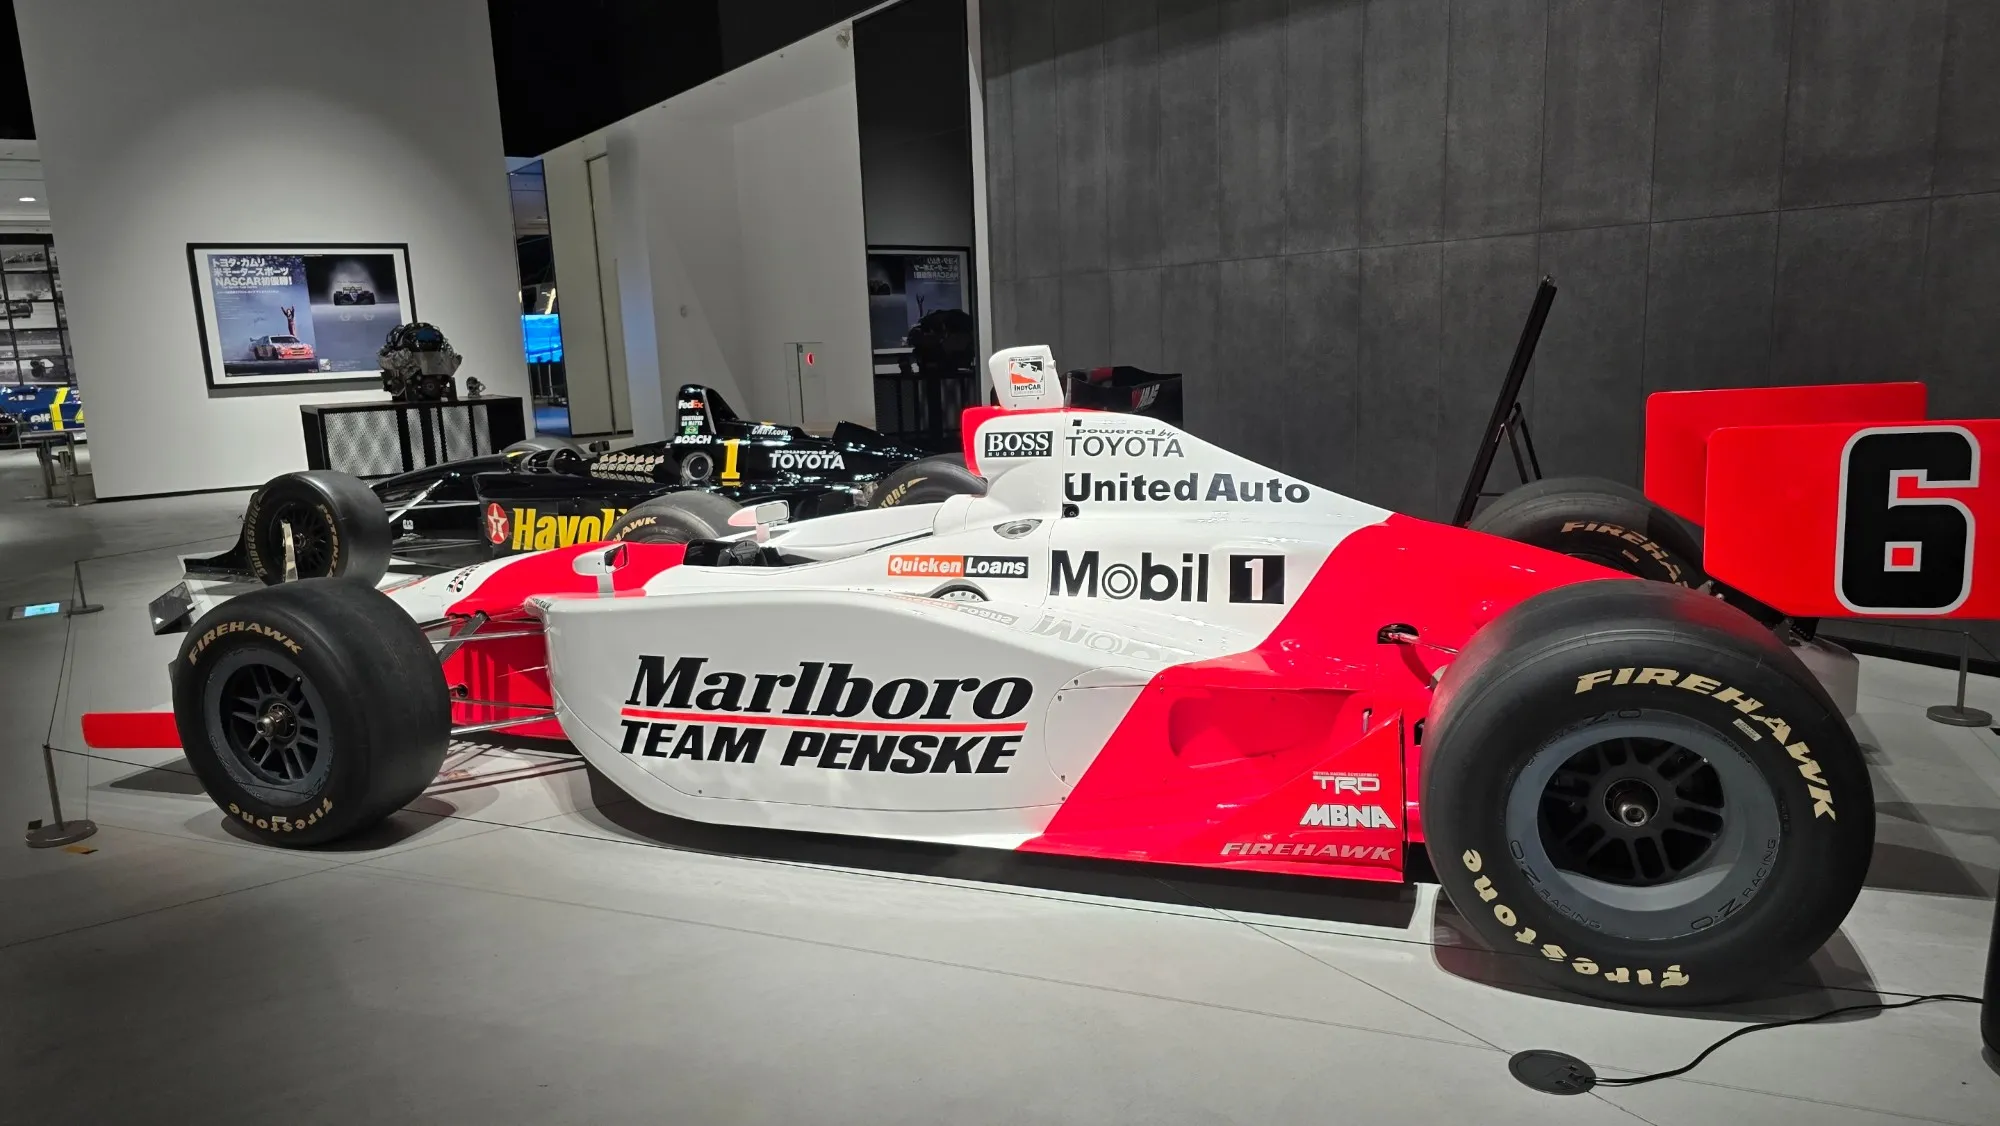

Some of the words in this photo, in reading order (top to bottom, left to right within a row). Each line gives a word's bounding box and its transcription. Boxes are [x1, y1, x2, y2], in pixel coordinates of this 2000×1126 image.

[678, 400, 704, 409] FedEx
[674, 434, 712, 444] BOSCH
[987, 432, 1050, 452] BOSS
[1065, 436, 1185, 458] TOYOTA
[1076, 428, 1156, 436] powered
[1157, 428, 1179, 439] by
[721, 438, 741, 480] 1
[768, 453, 845, 470] TOYOTA
[1064, 472, 1199, 503] United
[1204, 472, 1311, 504] Auto
[1833, 424, 1981, 616] 6
[889, 556, 963, 575] Quicken
[965, 556, 1027, 578] Loans
[1049, 549, 1210, 603] Mobil
[188, 621, 303, 666] FIREHAWK
[624, 655, 1034, 721] Marlboro
[620, 719, 769, 764] TEAM
[779, 729, 1023, 775] PENSKE
[1574, 667, 1836, 822] FIREHAWK
[1312, 775, 1380, 796] TRD
[228, 797, 333, 833] Firestone
[1299, 803, 1397, 829] MBNA
[1219, 842, 1397, 861] FIREHAWK
[1742, 838, 1777, 898] RACING
[1462, 848, 1691, 989] Firestone
[1539, 888, 1602, 930] RACING
